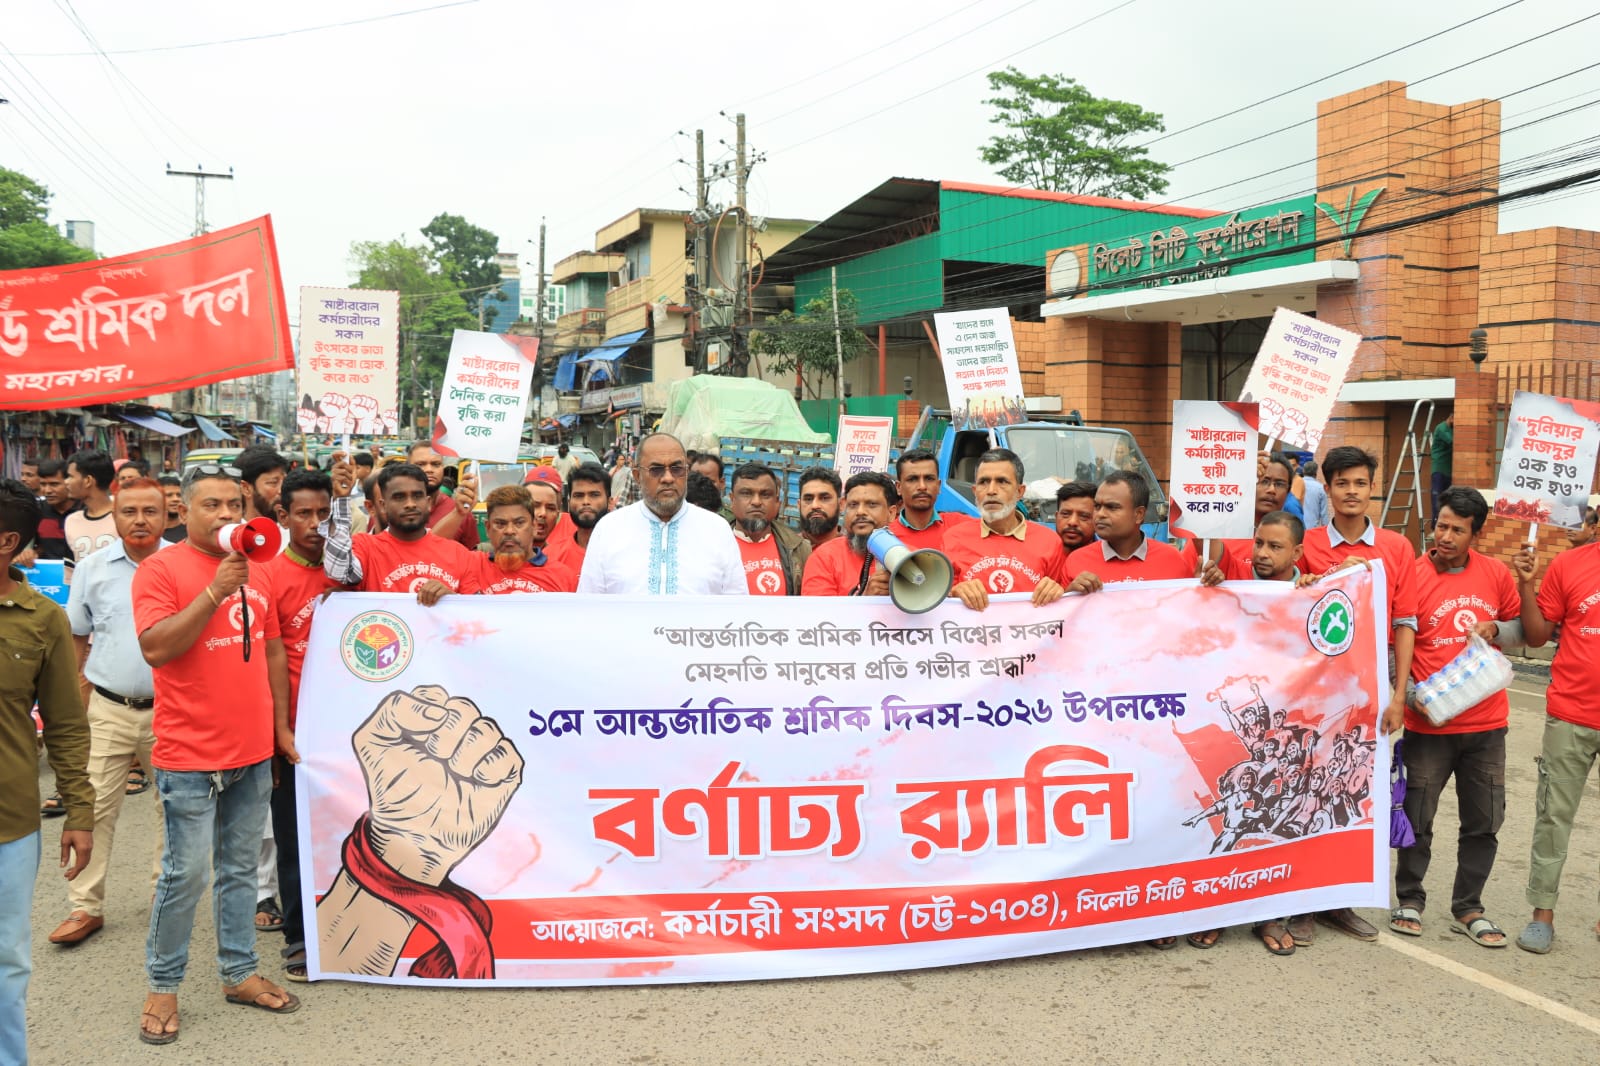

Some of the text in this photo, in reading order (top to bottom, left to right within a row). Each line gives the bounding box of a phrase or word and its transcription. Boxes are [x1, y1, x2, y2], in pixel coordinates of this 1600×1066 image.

[1093, 209, 1303, 275] সিলেট সিটি কর্পোরেশন
[36, 286, 170, 353] শ্রমিক
[179, 268, 254, 326] দল
[318, 312, 381, 327] কর্মচারীদের
[335, 329, 364, 340] সকল
[955, 334, 961, 342] এ
[361, 345, 384, 355] ভাতা
[1283, 333, 1338, 359] কর্মচারীদের
[309, 355, 332, 371] বৃদ্ধি
[335, 359, 357, 369] করা
[462, 356, 520, 373] মাষ্টাররোল
[1293, 349, 1319, 365] সকল
[322, 373, 346, 383] করে
[456, 371, 520, 390] কর্মচারীদের
[1262, 365, 1282, 378] বৃদ্ধি
[1283, 373, 1303, 386] করা
[1310, 369, 1331, 384] ভাতা
[449, 386, 520, 406] দৈনিক বেতন
[1268, 381, 1289, 394] করে
[457, 404, 506, 422] বৃদ্ধি করা
[464, 425, 493, 438] হোক
[1184, 443, 1246, 461] কর্মচারীদের
[1521, 437, 1577, 461] মজদুর
[849, 454, 875, 465] সফল
[1518, 457, 1578, 479] এক হও
[1202, 461, 1227, 479] স্থায়ী
[1183, 483, 1216, 496] করতে
[1513, 475, 1544, 491] এক
[1186, 501, 1210, 513] করে
[653, 619, 1064, 648] “আন্তর্জাতিক শ্রমিক দিবসে বিশ্বের সকল
[685, 652, 1037, 685] মেহনতি মানুষের প্রতি গভীর শ্রদ্ধা”
[528, 690, 1187, 739] ১মে আন্তর্জাতিক শ্রমিক দিবস-২০২৬ উপলক্ষে
[587, 760, 865, 858] বর্ণাঢ্য
[530, 916, 654, 944] আয়োজনে:
[661, 896, 783, 939] কর্মচারী
[791, 905, 890, 934] সংসদ
[1076, 886, 1139, 914] সিলেট
[1144, 876, 1187, 904] সিটি
[1192, 863, 1292, 897] কর্পোরেশন।
